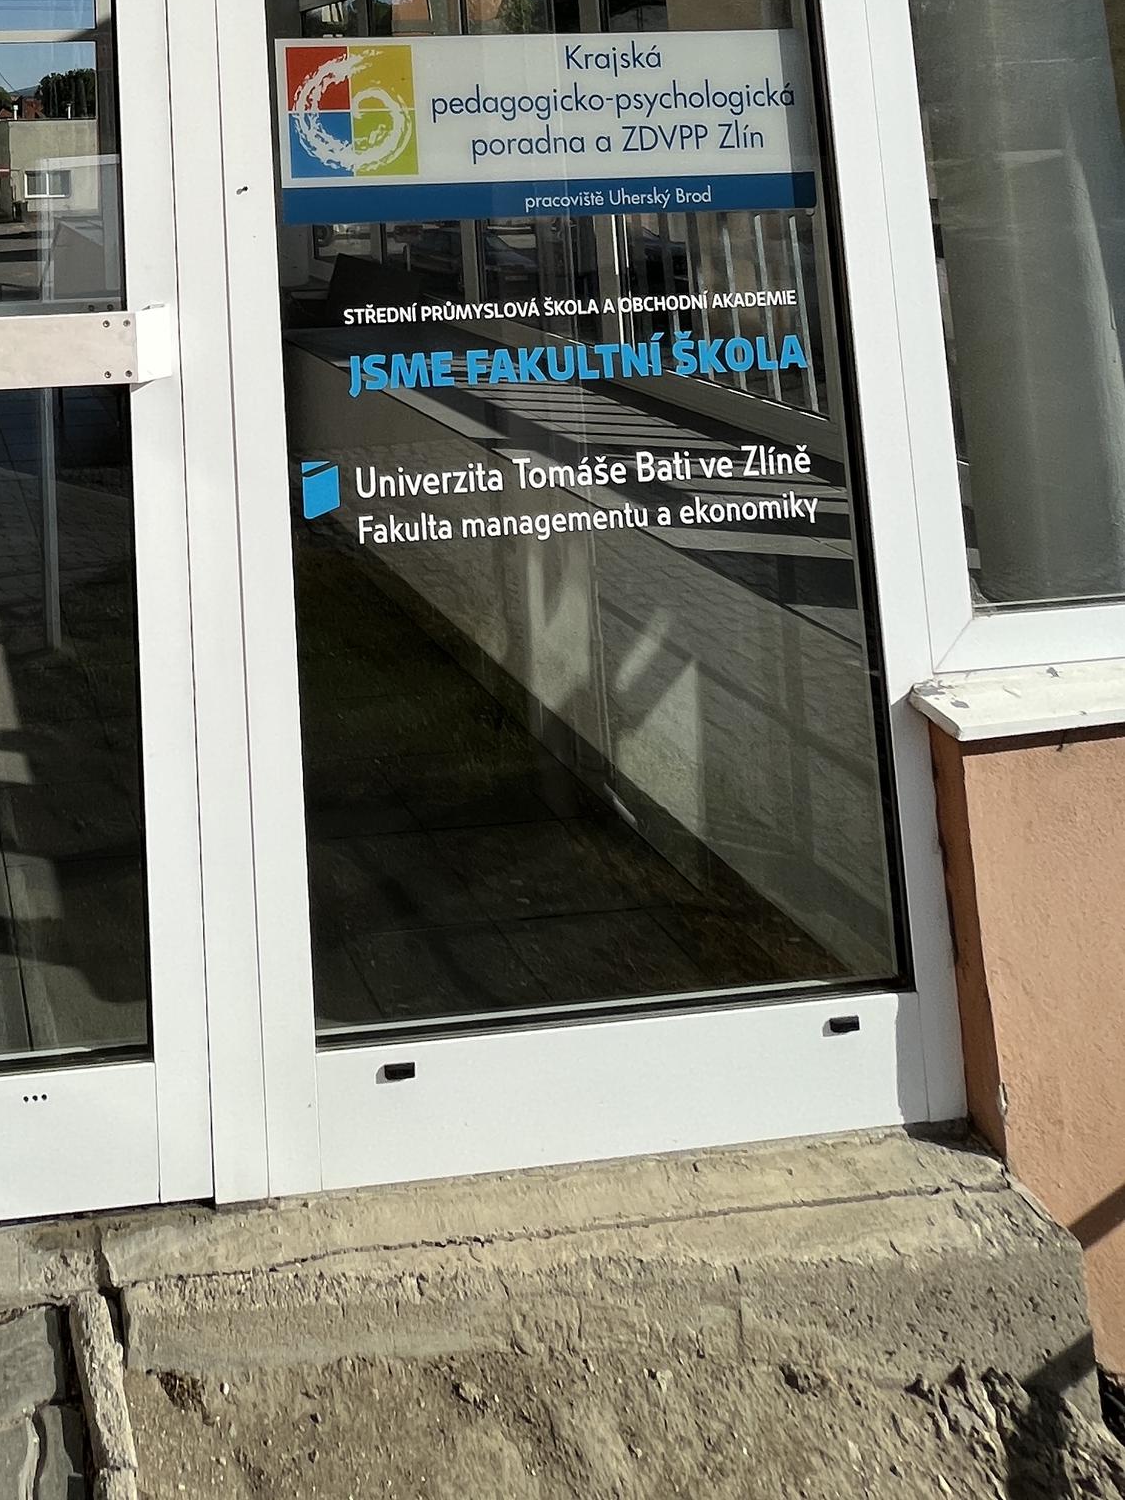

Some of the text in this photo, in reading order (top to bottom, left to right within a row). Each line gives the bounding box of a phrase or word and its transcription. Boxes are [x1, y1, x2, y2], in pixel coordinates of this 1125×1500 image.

[565, 40, 662, 78] Krajská
[430, 78, 796, 123] pedagogicko-psychologická
[471, 118, 765, 165] poradna a ZDVPP Zlín
[524, 185, 712, 213] pracoviště Uherský Brod
[343, 288, 798, 326] STŘEDNÍ PRŮMYSLOVÁ ŠKOLA A OBCHODNÍ AKADEMIE
[347, 329, 808, 399] JSME FAKULTNÍ ŠKOLA
[355, 444, 813, 499] Univerzita Tomáše Bati ve Zlíně
[358, 492, 819, 545] Fakulta managementu a ekonomiky
